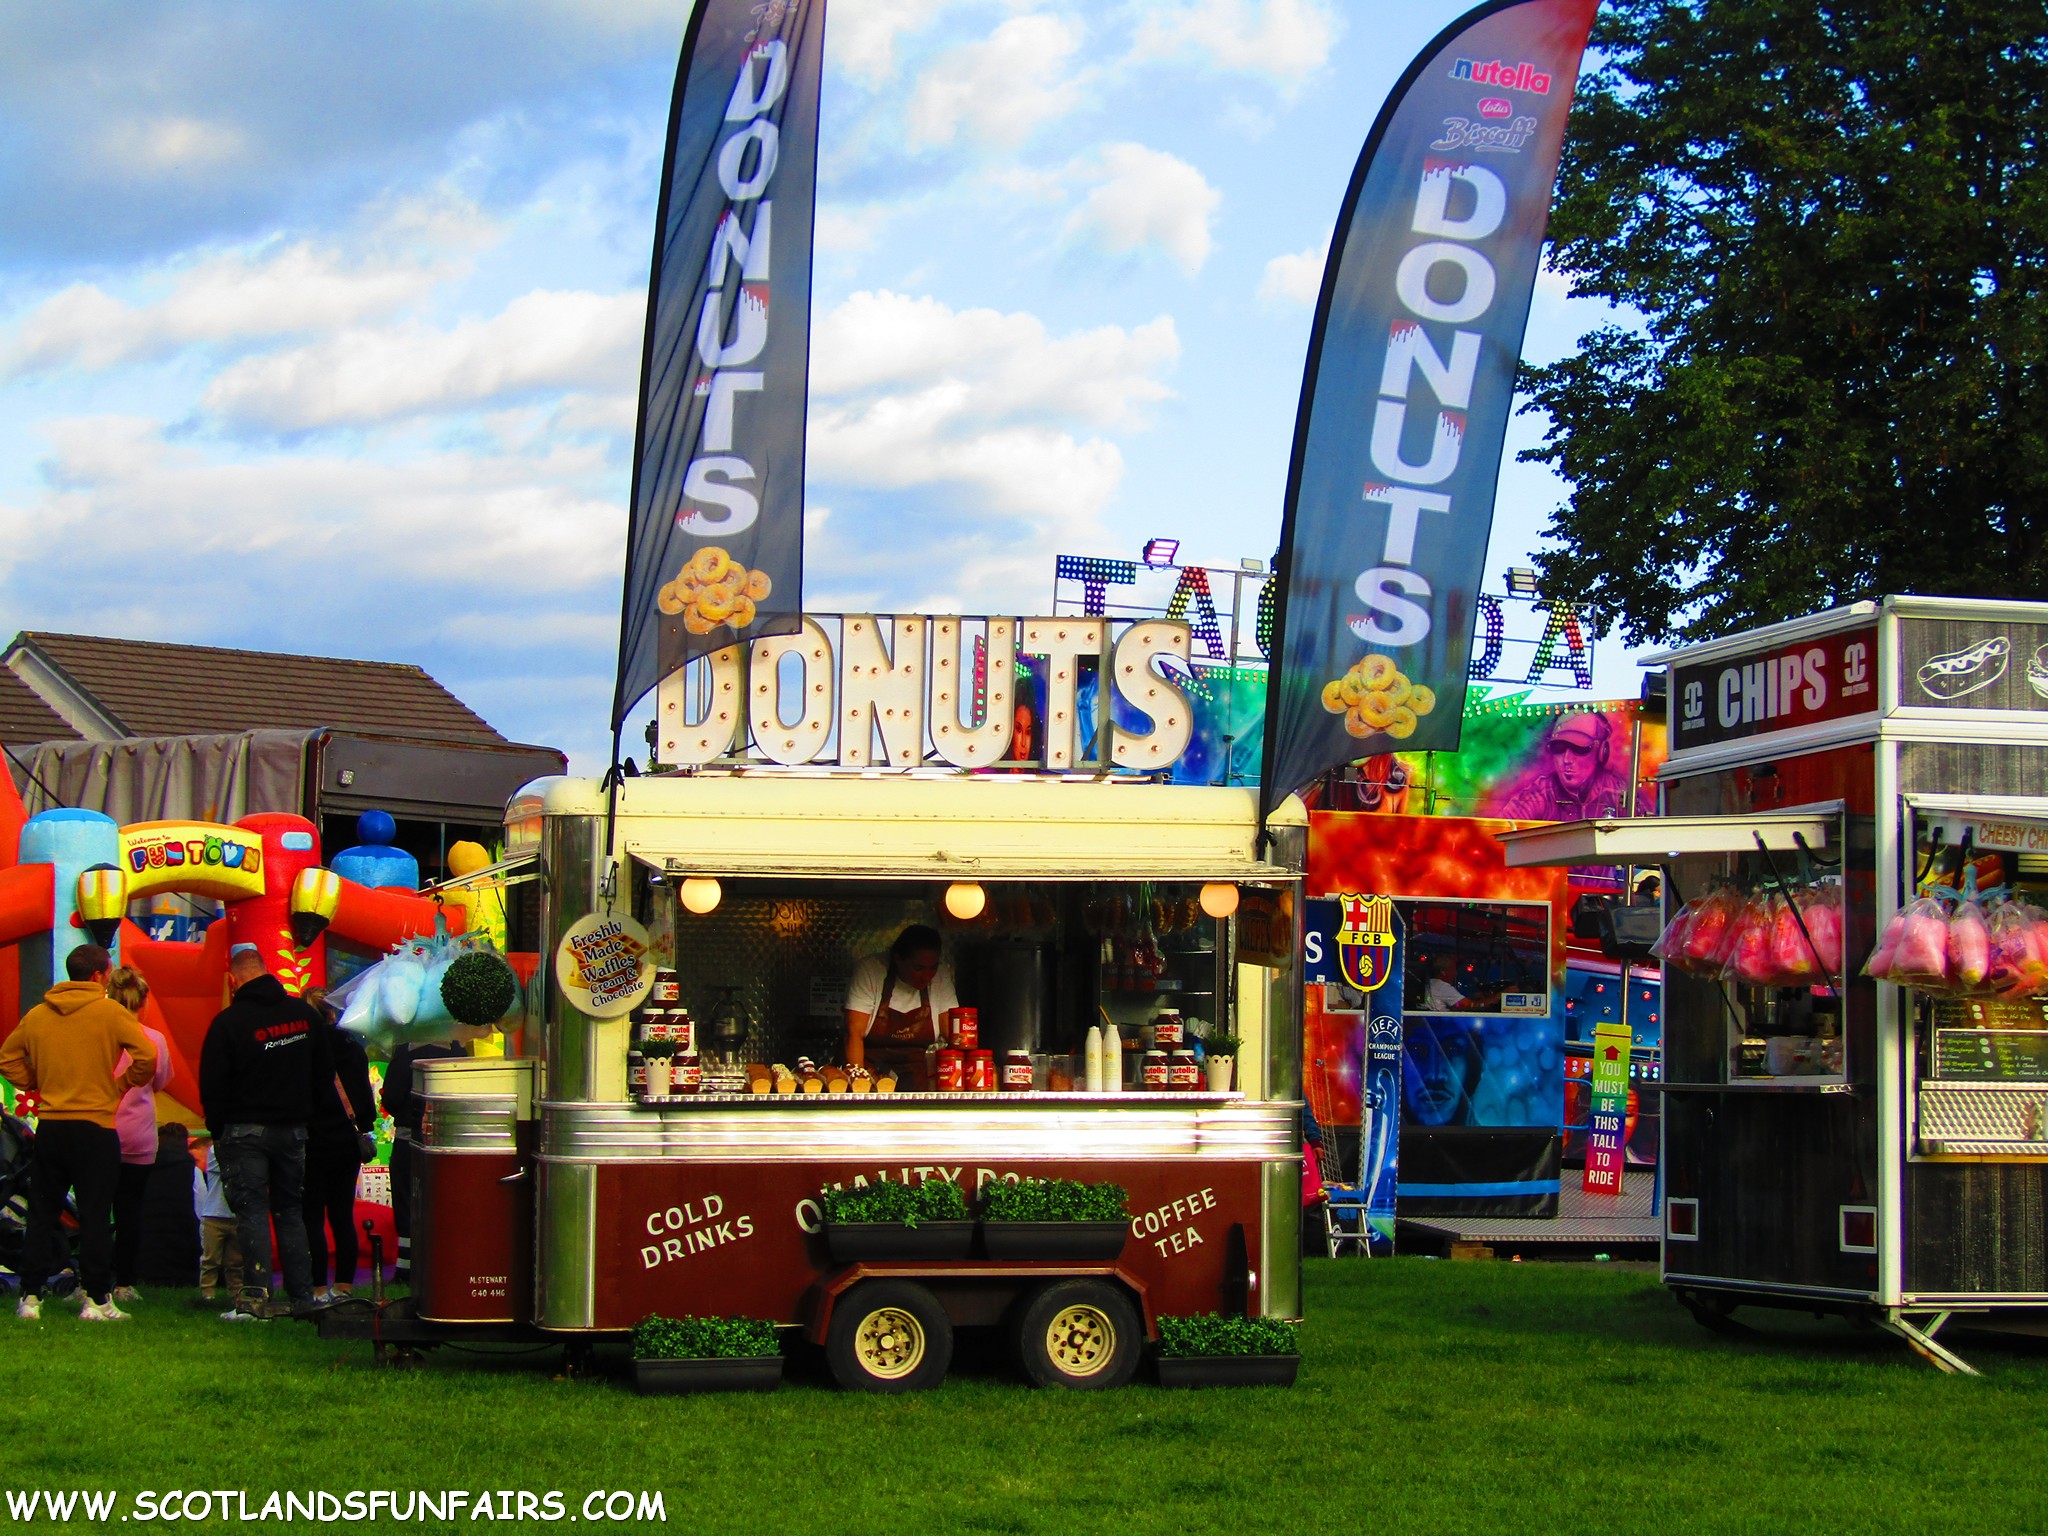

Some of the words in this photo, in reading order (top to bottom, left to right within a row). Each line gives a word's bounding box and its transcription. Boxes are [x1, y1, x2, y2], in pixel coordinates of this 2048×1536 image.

[1449, 58, 1551, 95] nutella
[1431, 116, 1537, 151] Biscoff
[675, 39, 787, 537] DONUTS
[1346, 155, 1507, 646] DONUTS
[656, 614, 1194, 769] DONUTS
[1717, 647, 1827, 728] CHIPS
[128, 836, 161, 847] Welcome
[1979, 822, 2027, 847] CHEESY
[129, 841, 185, 873] FUN
[186, 836, 260, 873] TOWN
[570, 921, 623, 950] Freshly
[583, 940, 623, 964] Made
[582, 954, 636, 982] Waffles
[590, 975, 626, 994] Cream
[626, 967, 638, 979] &
[592, 980, 645, 1007] Chocolate
[267, 1019, 310, 1038] YAMAHA
[1371, 1018, 1399, 1037] UEFA
[1368, 1042, 1401, 1052] CHAMPIONS
[1373, 1052, 1396, 1061] LEAGUE
[1170, 1066, 1196, 1075] nutella
[1600, 1061, 1622, 1077] YOU
[1593, 1079, 1625, 1095] MUST
[1600, 1098, 1615, 1113] BE
[1593, 1115, 1619, 1131] THIS
[1592, 1133, 1617, 1150] TALL
[1596, 1151, 1611, 1167] TO
[1588, 1170, 1614, 1186] RIDE
[646, 1194, 724, 1236] COLD
[1131, 1187, 1217, 1239] COFFEE
[640, 1215, 755, 1270] DRINKS
[1154, 1226, 1204, 1259] TEA
